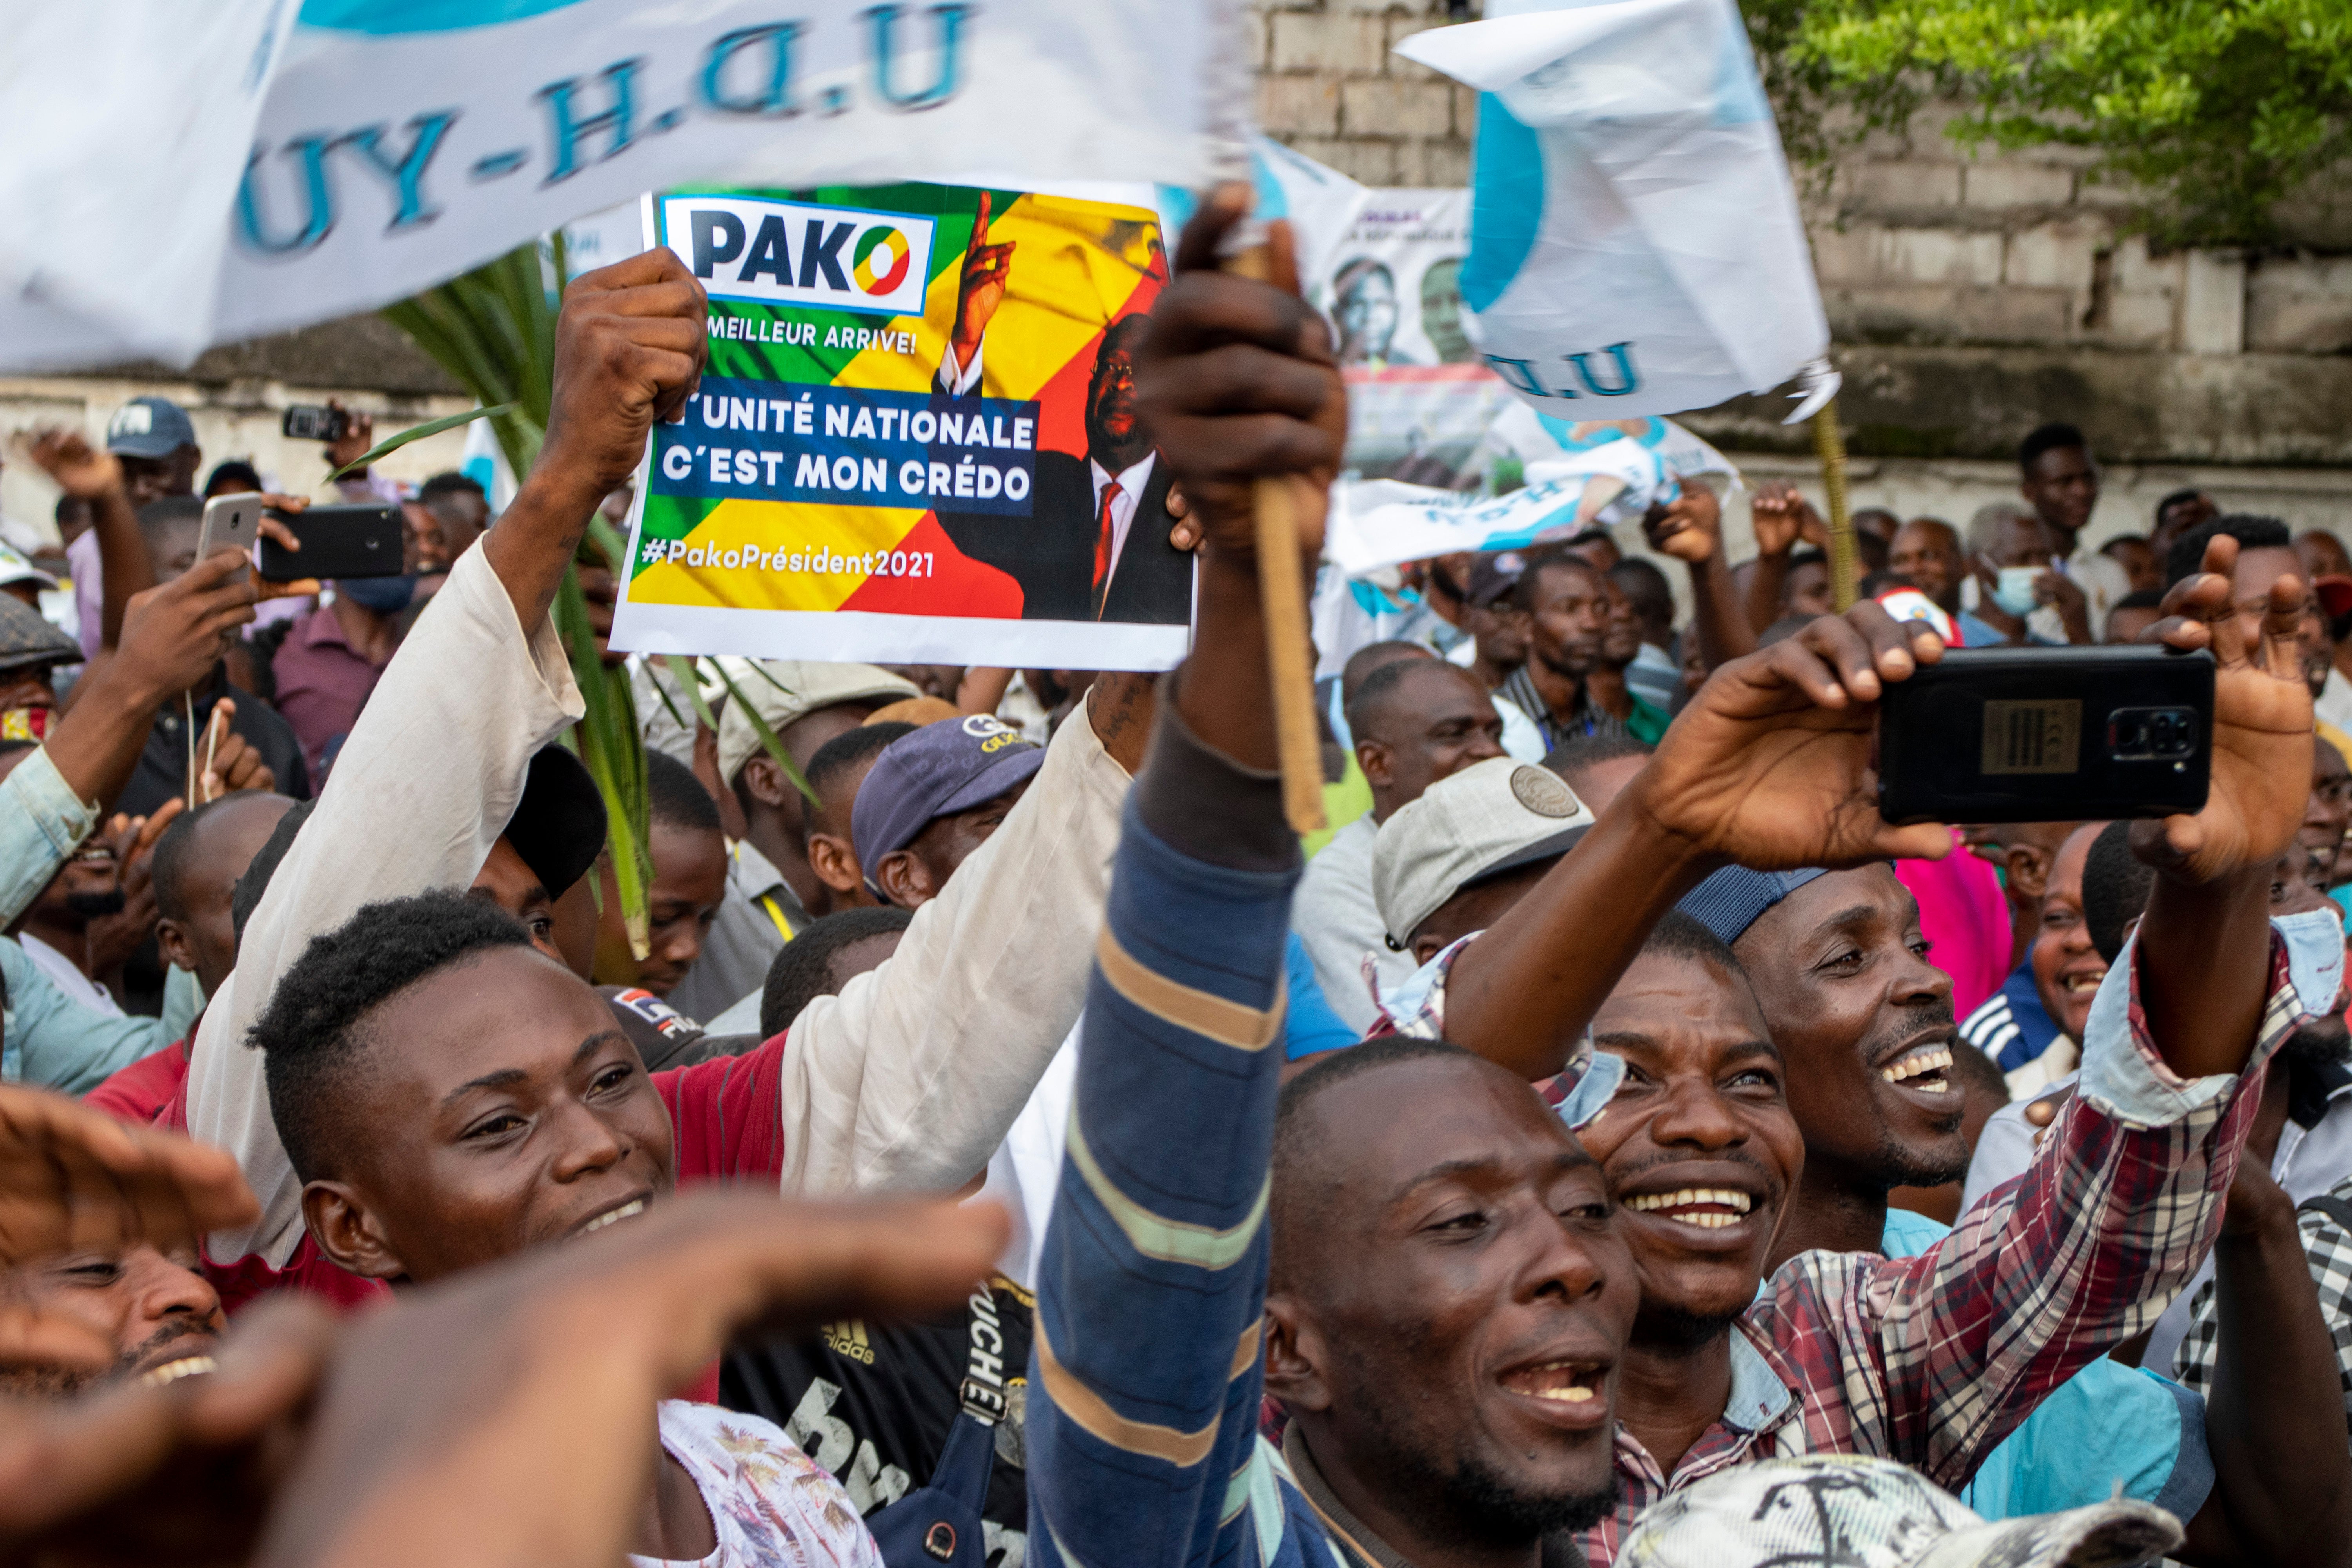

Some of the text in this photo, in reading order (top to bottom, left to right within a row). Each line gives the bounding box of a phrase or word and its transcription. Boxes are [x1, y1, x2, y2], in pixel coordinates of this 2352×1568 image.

[691, 210, 910, 296] PAKO
[707, 315, 916, 355] MEILLEUR ARRIVE!
[666, 392, 1034, 450] 'UNITÉ NATIONALE
[794, 456, 887, 493] MON
[898, 455, 1031, 502] CRÉDO
[641, 537, 934, 579] #PakoPrésident2021
